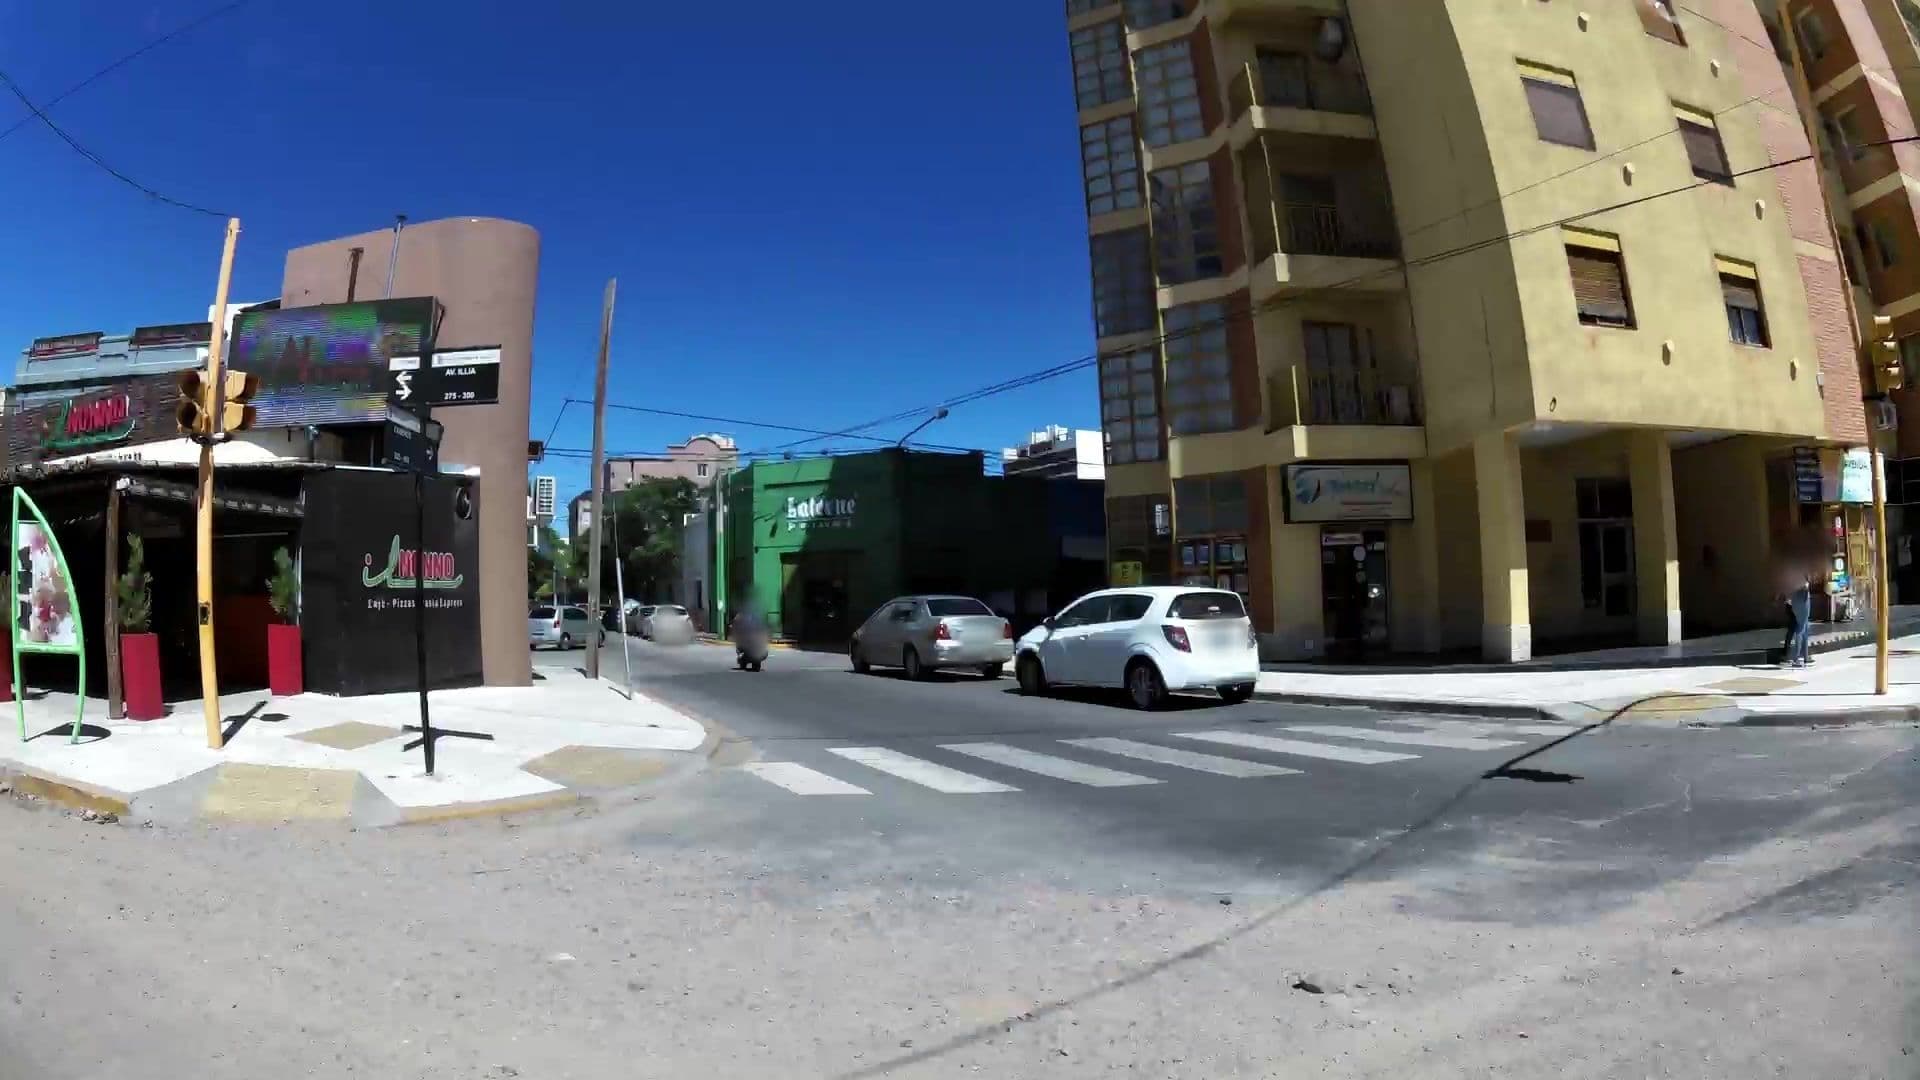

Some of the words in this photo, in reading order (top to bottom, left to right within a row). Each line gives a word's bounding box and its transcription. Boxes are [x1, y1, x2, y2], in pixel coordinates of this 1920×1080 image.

[445, 368, 457, 377] AV.
[457, 367, 477, 376] ILLIA
[423, 599, 439, 609] asta
